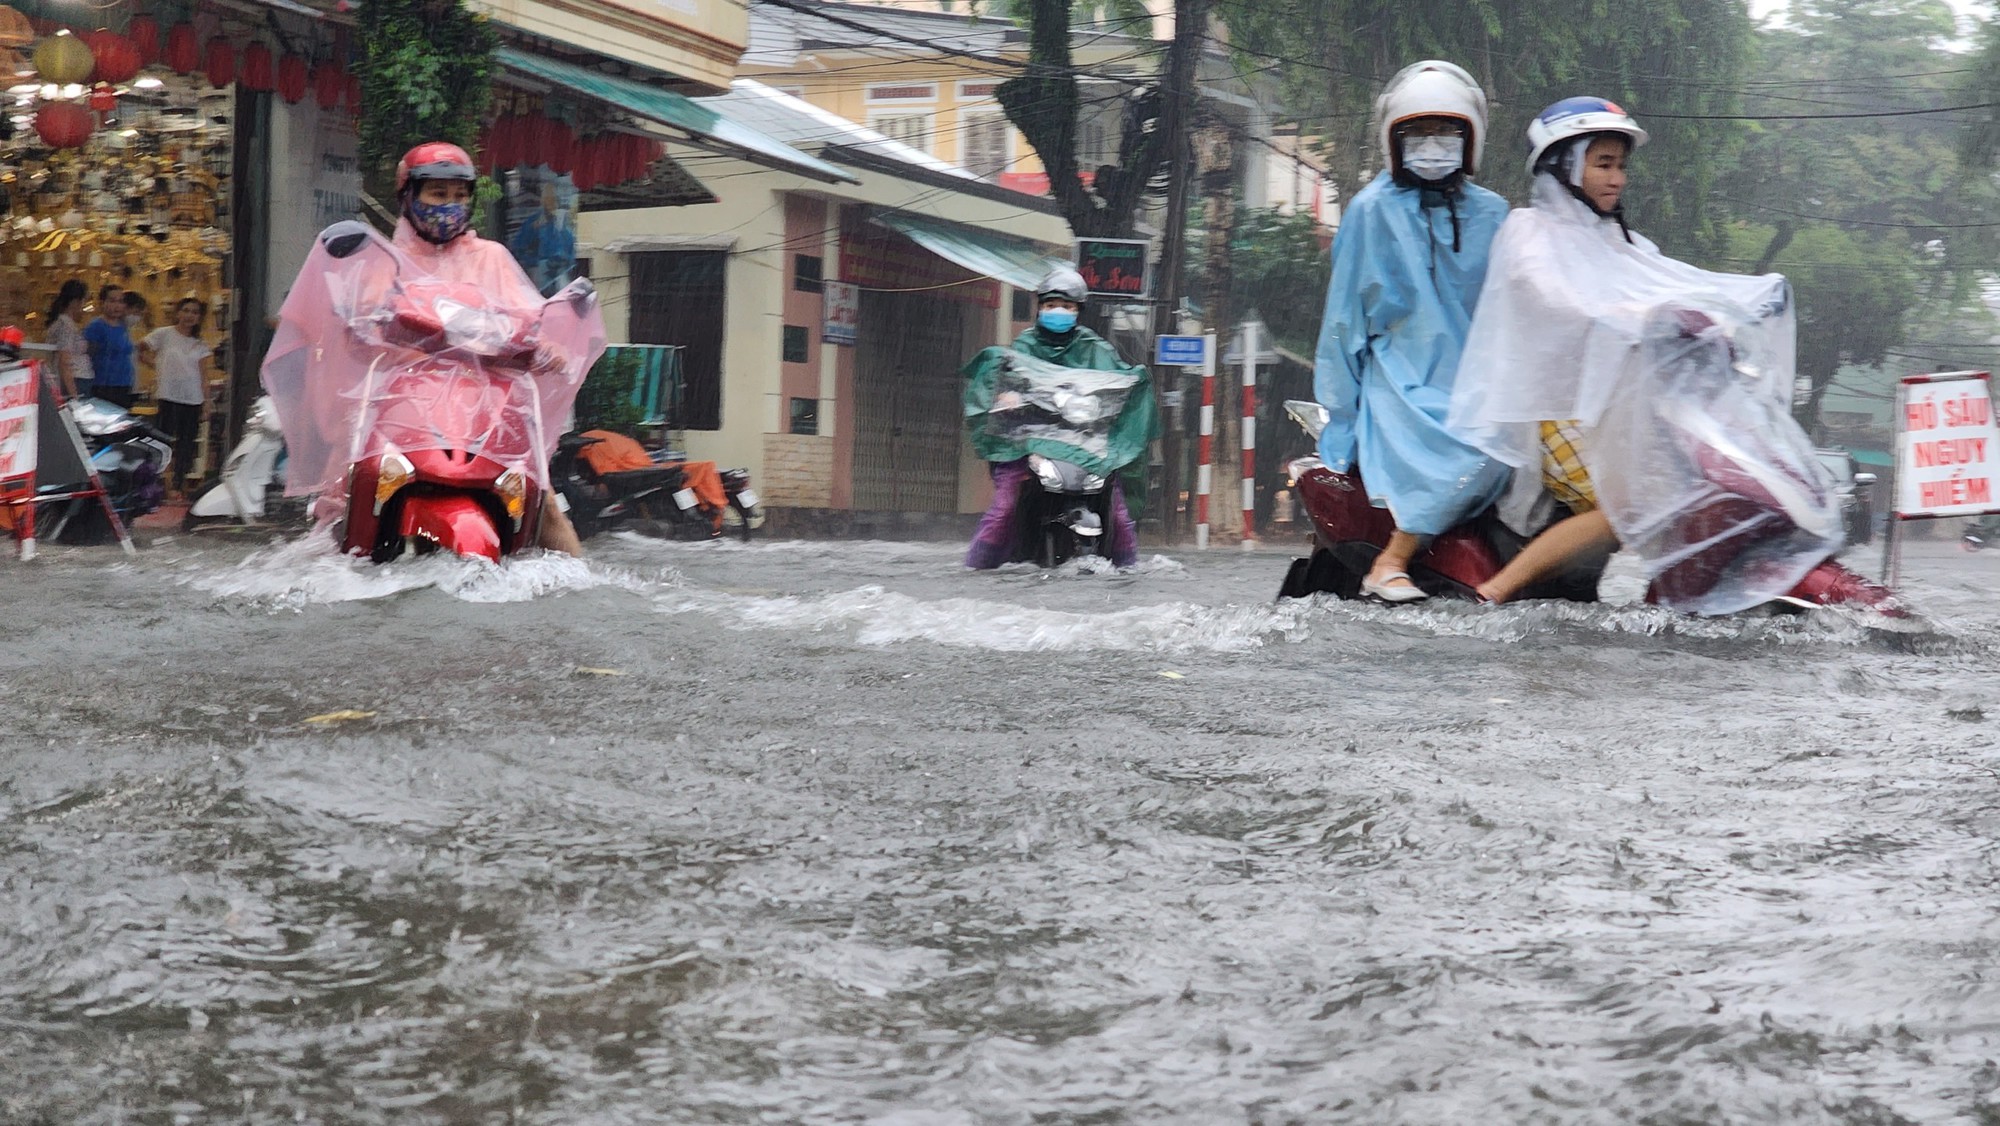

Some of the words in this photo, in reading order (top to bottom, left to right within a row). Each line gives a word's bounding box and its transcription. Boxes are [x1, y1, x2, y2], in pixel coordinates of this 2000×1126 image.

[1904, 391, 1939, 431] HỐ
[1943, 392, 1990, 427] SÂU
[1914, 437, 1988, 468] NGUY
